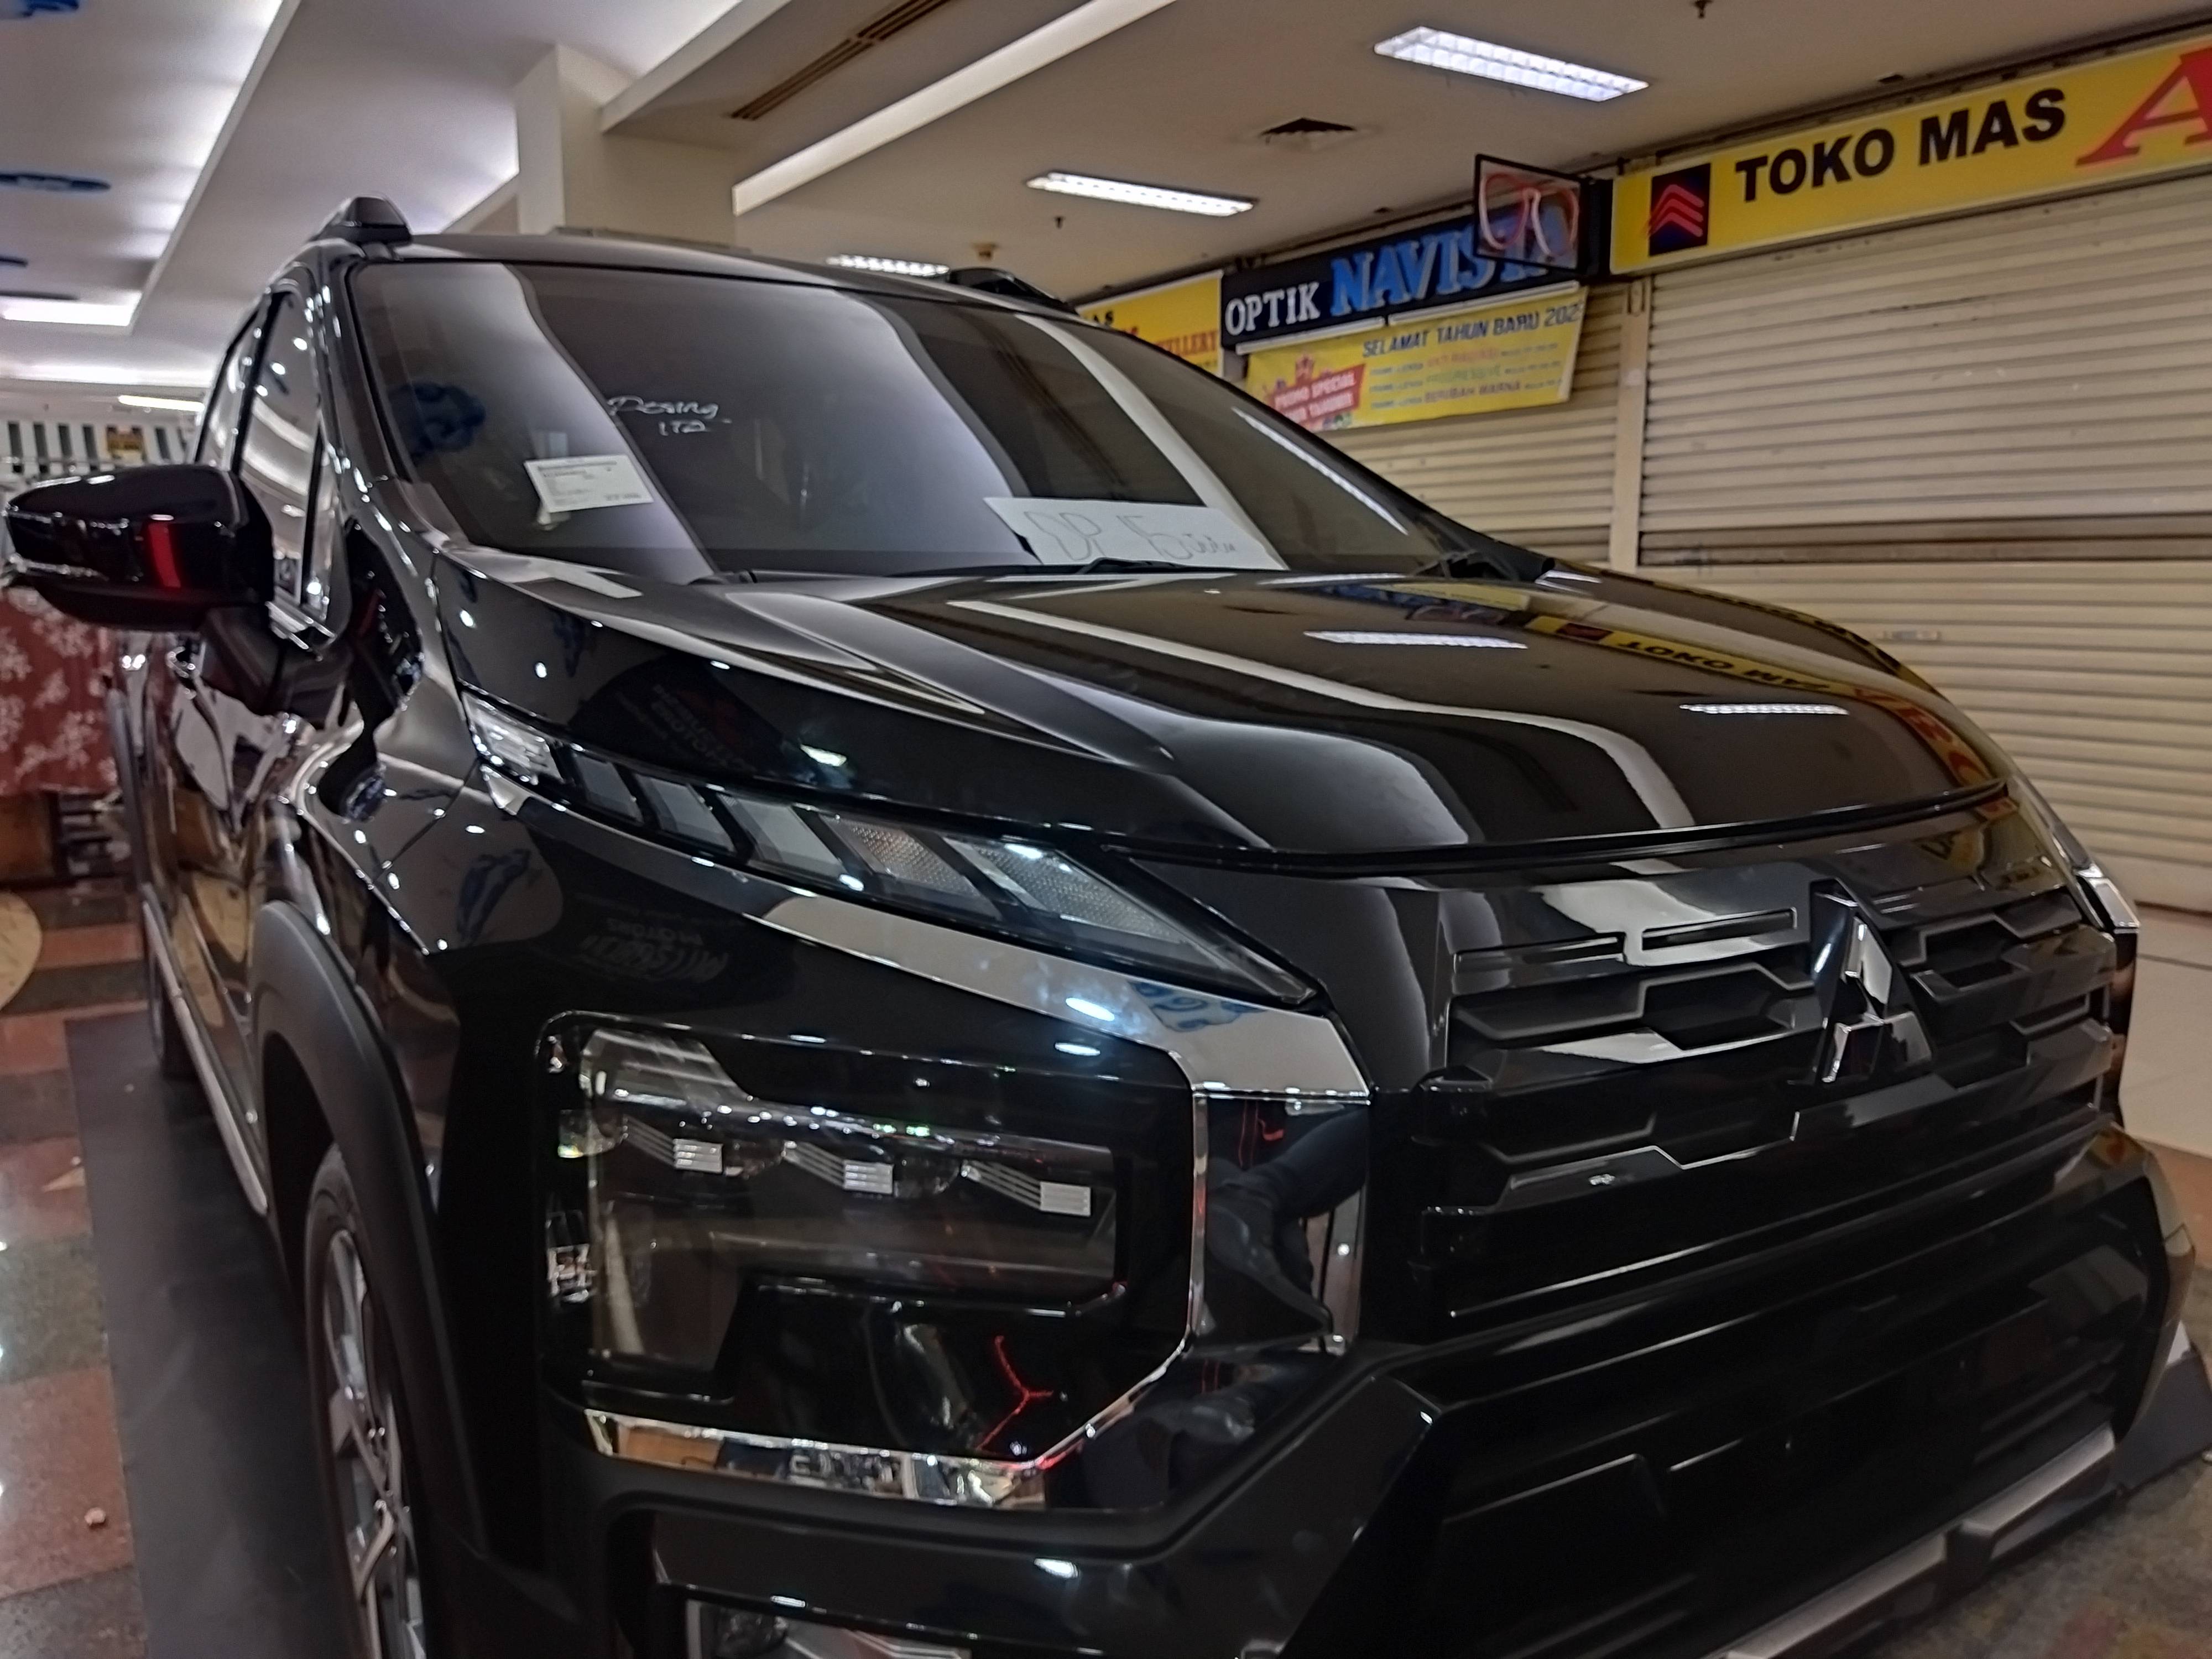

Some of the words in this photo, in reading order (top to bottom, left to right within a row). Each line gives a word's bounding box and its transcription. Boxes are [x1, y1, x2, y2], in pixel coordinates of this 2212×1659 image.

[1736, 128, 1895, 202] TOKO
[1919, 88, 2065, 166] MAS
[2076, 46, 2212, 166] A
[1225, 281, 1321, 336] OPTIK
[1363, 331, 1428, 358] SELAMAT
[1437, 320, 1489, 343] TAHUN
[1493, 311, 1540, 336] BARU
